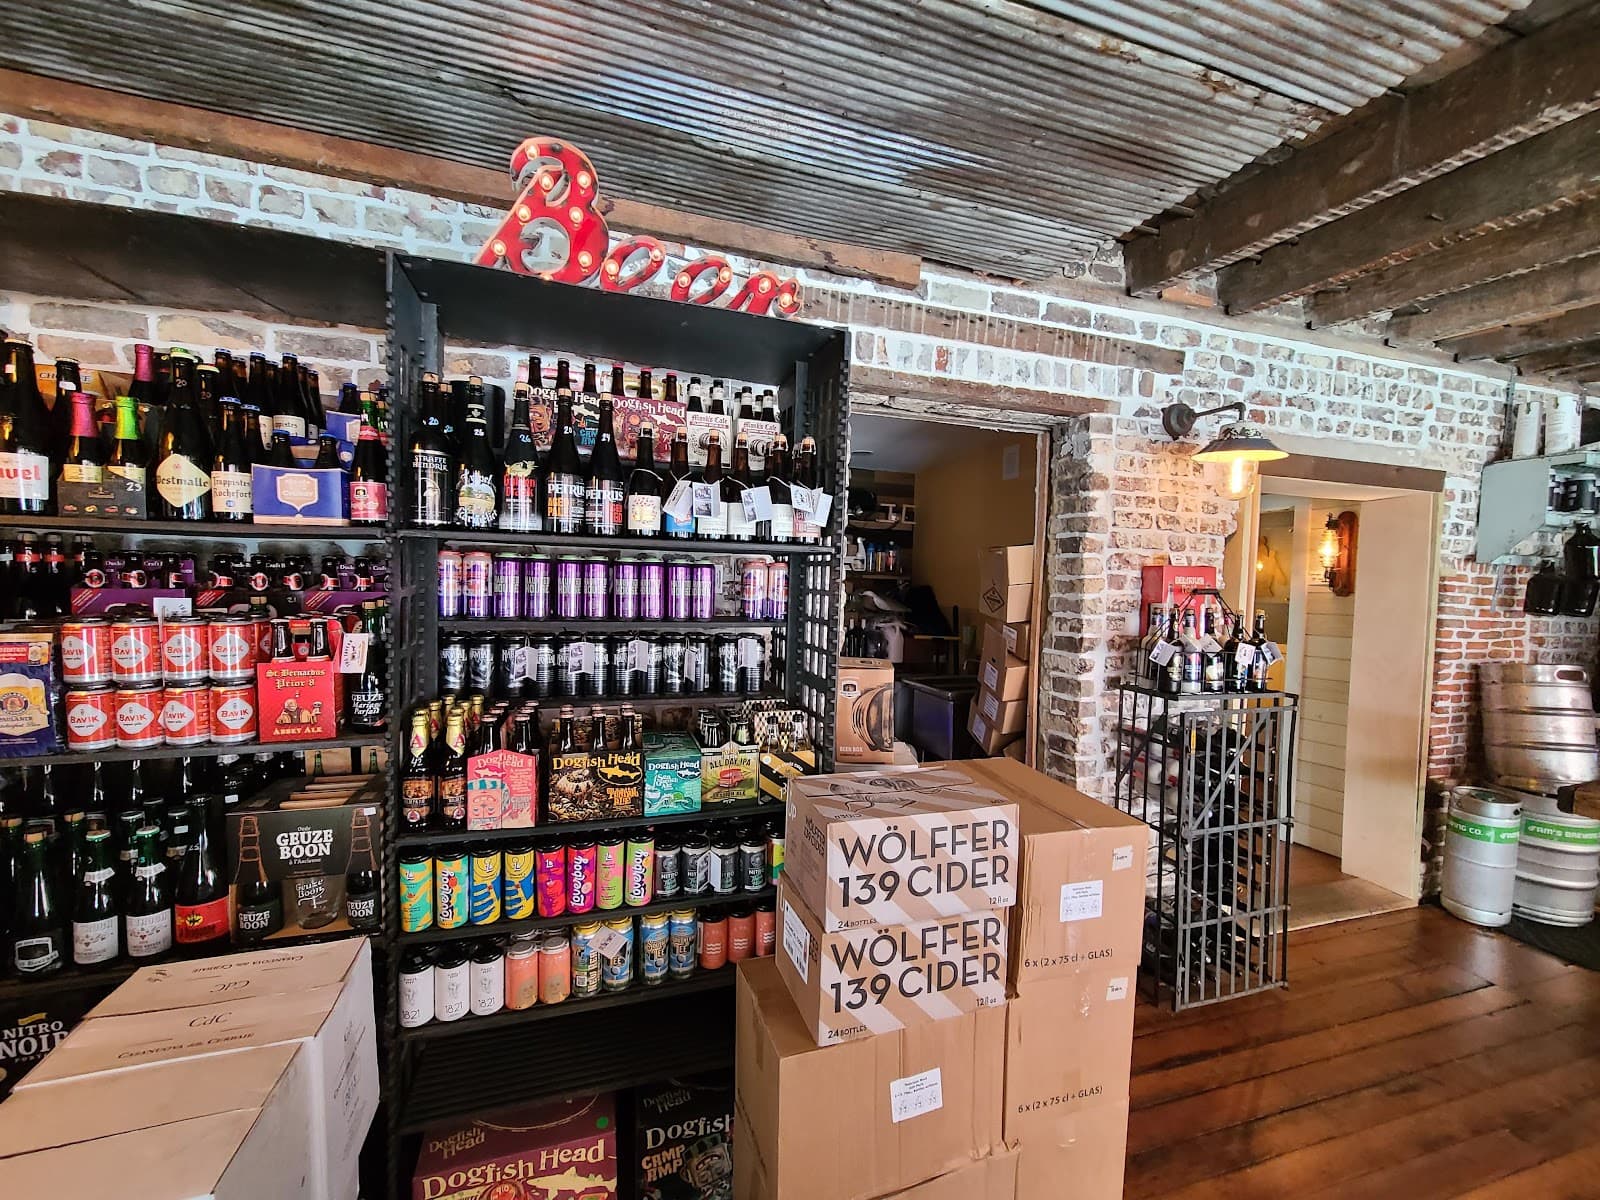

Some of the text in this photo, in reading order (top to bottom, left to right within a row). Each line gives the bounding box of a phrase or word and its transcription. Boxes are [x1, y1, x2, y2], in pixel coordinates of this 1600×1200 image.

[657, 401, 686, 418] Head
[586, 490, 624, 502] PETRUS
[71, 715, 99, 724] BAVIK
[119, 714, 147, 722] BAVIK
[221, 710, 249, 718] BAVIK
[478, 753, 518, 768] Dogfish
[552, 752, 641, 770] Dogfish Head
[648, 762, 680, 771] Dogfish
[709, 759, 723, 770] ALL
[276, 829, 334, 846] GEUZE
[1469, 827, 1482, 836] CO.
[279, 843, 333, 860] BOON
[838, 819, 1010, 869] WÖLFFER
[570, 856, 589, 908] Loverboy
[630, 849, 649, 900] Loverboy
[661, 871, 679, 880] NITRO
[839, 855, 1009, 907] 139 CIDER
[439, 869, 455, 923] Loverboy
[988, 896, 998, 905] 12
[238, 911, 271, 922] GEUZE
[837, 917, 878, 929] 24 BOTTLES
[830, 917, 1001, 974] WÖLFFER
[1024, 958, 1030, 968] 6
[1040, 957, 1050, 968] (2
[1059, 955, 1069, 965] 75
[1071, 953, 1078, 963] cl
[1087, 948, 1113, 960] GLAS)
[830, 952, 1001, 1014] 139 CIDER
[976, 998, 984, 1007] 12
[188, 1012, 233, 1028] CdC
[3, 1020, 64, 1040] NITRO
[827, 1025, 868, 1039] 24 BOTTLES
[1018, 1104, 1023, 1113] 6
[1032, 1099, 1042, 1110] (2
[1050, 1095, 1060, 1105] 75
[1062, 1093, 1069, 1103] cl
[1078, 1085, 1103, 1098] GLAS)
[429, 1127, 482, 1153] Dogfish
[443, 1131, 485, 1160] Head
[421, 1139, 606, 1200] Dogfish Head
